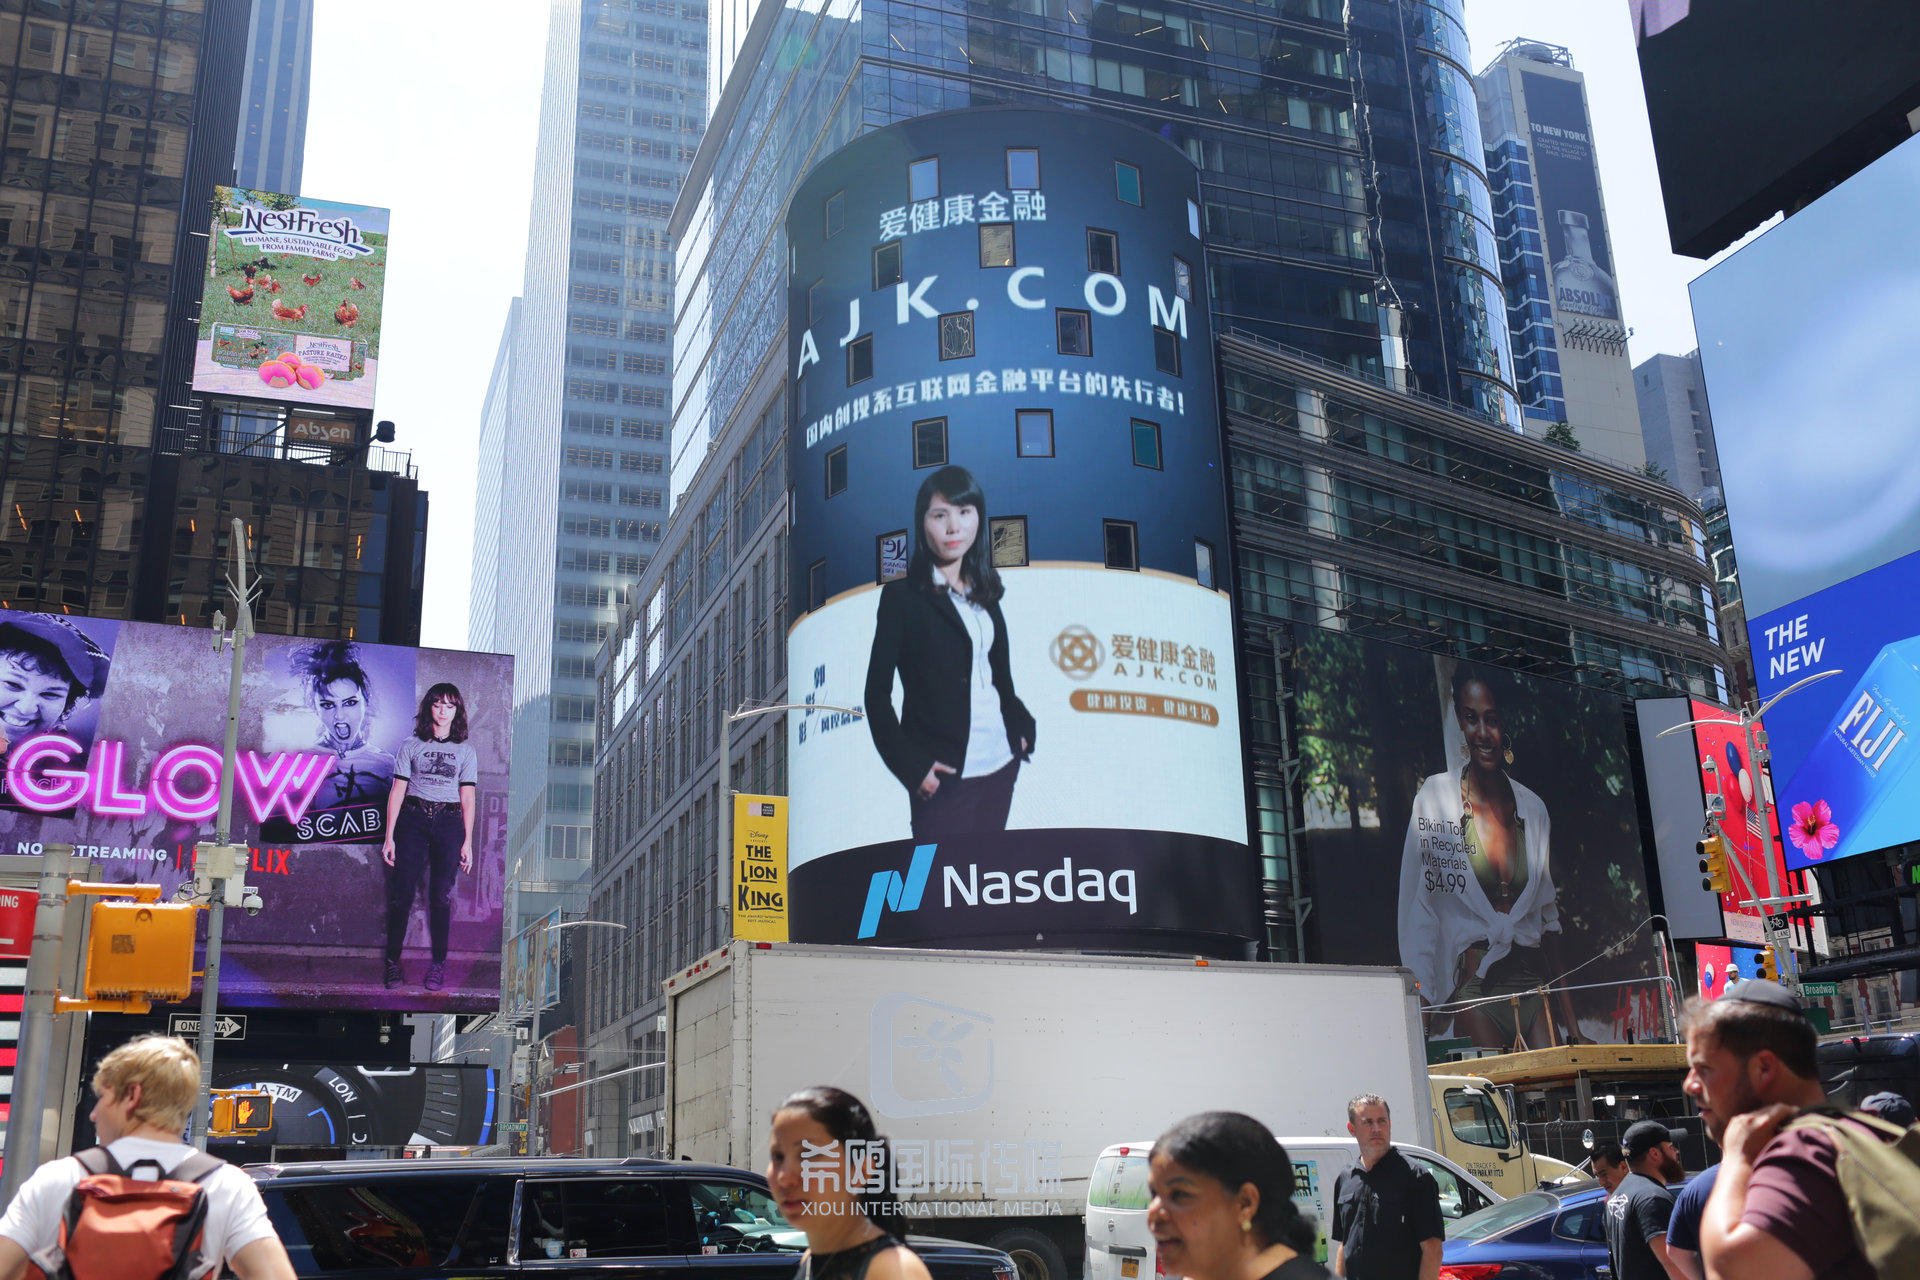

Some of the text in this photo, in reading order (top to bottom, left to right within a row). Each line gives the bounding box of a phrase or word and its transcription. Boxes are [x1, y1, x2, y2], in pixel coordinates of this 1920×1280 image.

[1530, 122, 1541, 133] TO
[1543, 125, 1562, 137] NEW
[245, 207, 359, 245] NestFresh
[879, 190, 1047, 241] 爱健康金融
[245, 236, 353, 256] HUMANE, SUSTAINABLE EGGS
[262, 243, 336, 259] FROM FAMILY FARMS
[294, 421, 351, 441] Absen
[1764, 614, 1809, 651] THE
[1112, 633, 1216, 676] 爱健康金融
[1769, 637, 1826, 680] NEW
[1838, 689, 1906, 772] FIJI
[7, 735, 338, 824] GLOW
[297, 808, 382, 841] SCAB
[1418, 817, 1466, 839] Bikini Top
[745, 844, 772, 859] THE
[1420, 835, 1477, 856] in Recycled
[1421, 852, 1468, 871] Materials
[944, 856, 1137, 915] Nasdaq
[1424, 868, 1467, 895] $4.99
[0, 894, 19, 908] ING
[1777, 929, 1789, 938] LANE
[1805, 985, 1835, 995] Broadway
[1610, 985, 1659, 1042] H&M
[180, 1021, 201, 1031] ONE
[259, 1083, 298, 1100] A-TM
[328, 1076, 358, 1104] LON
[499, 1123, 526, 1132] BROADWAY
